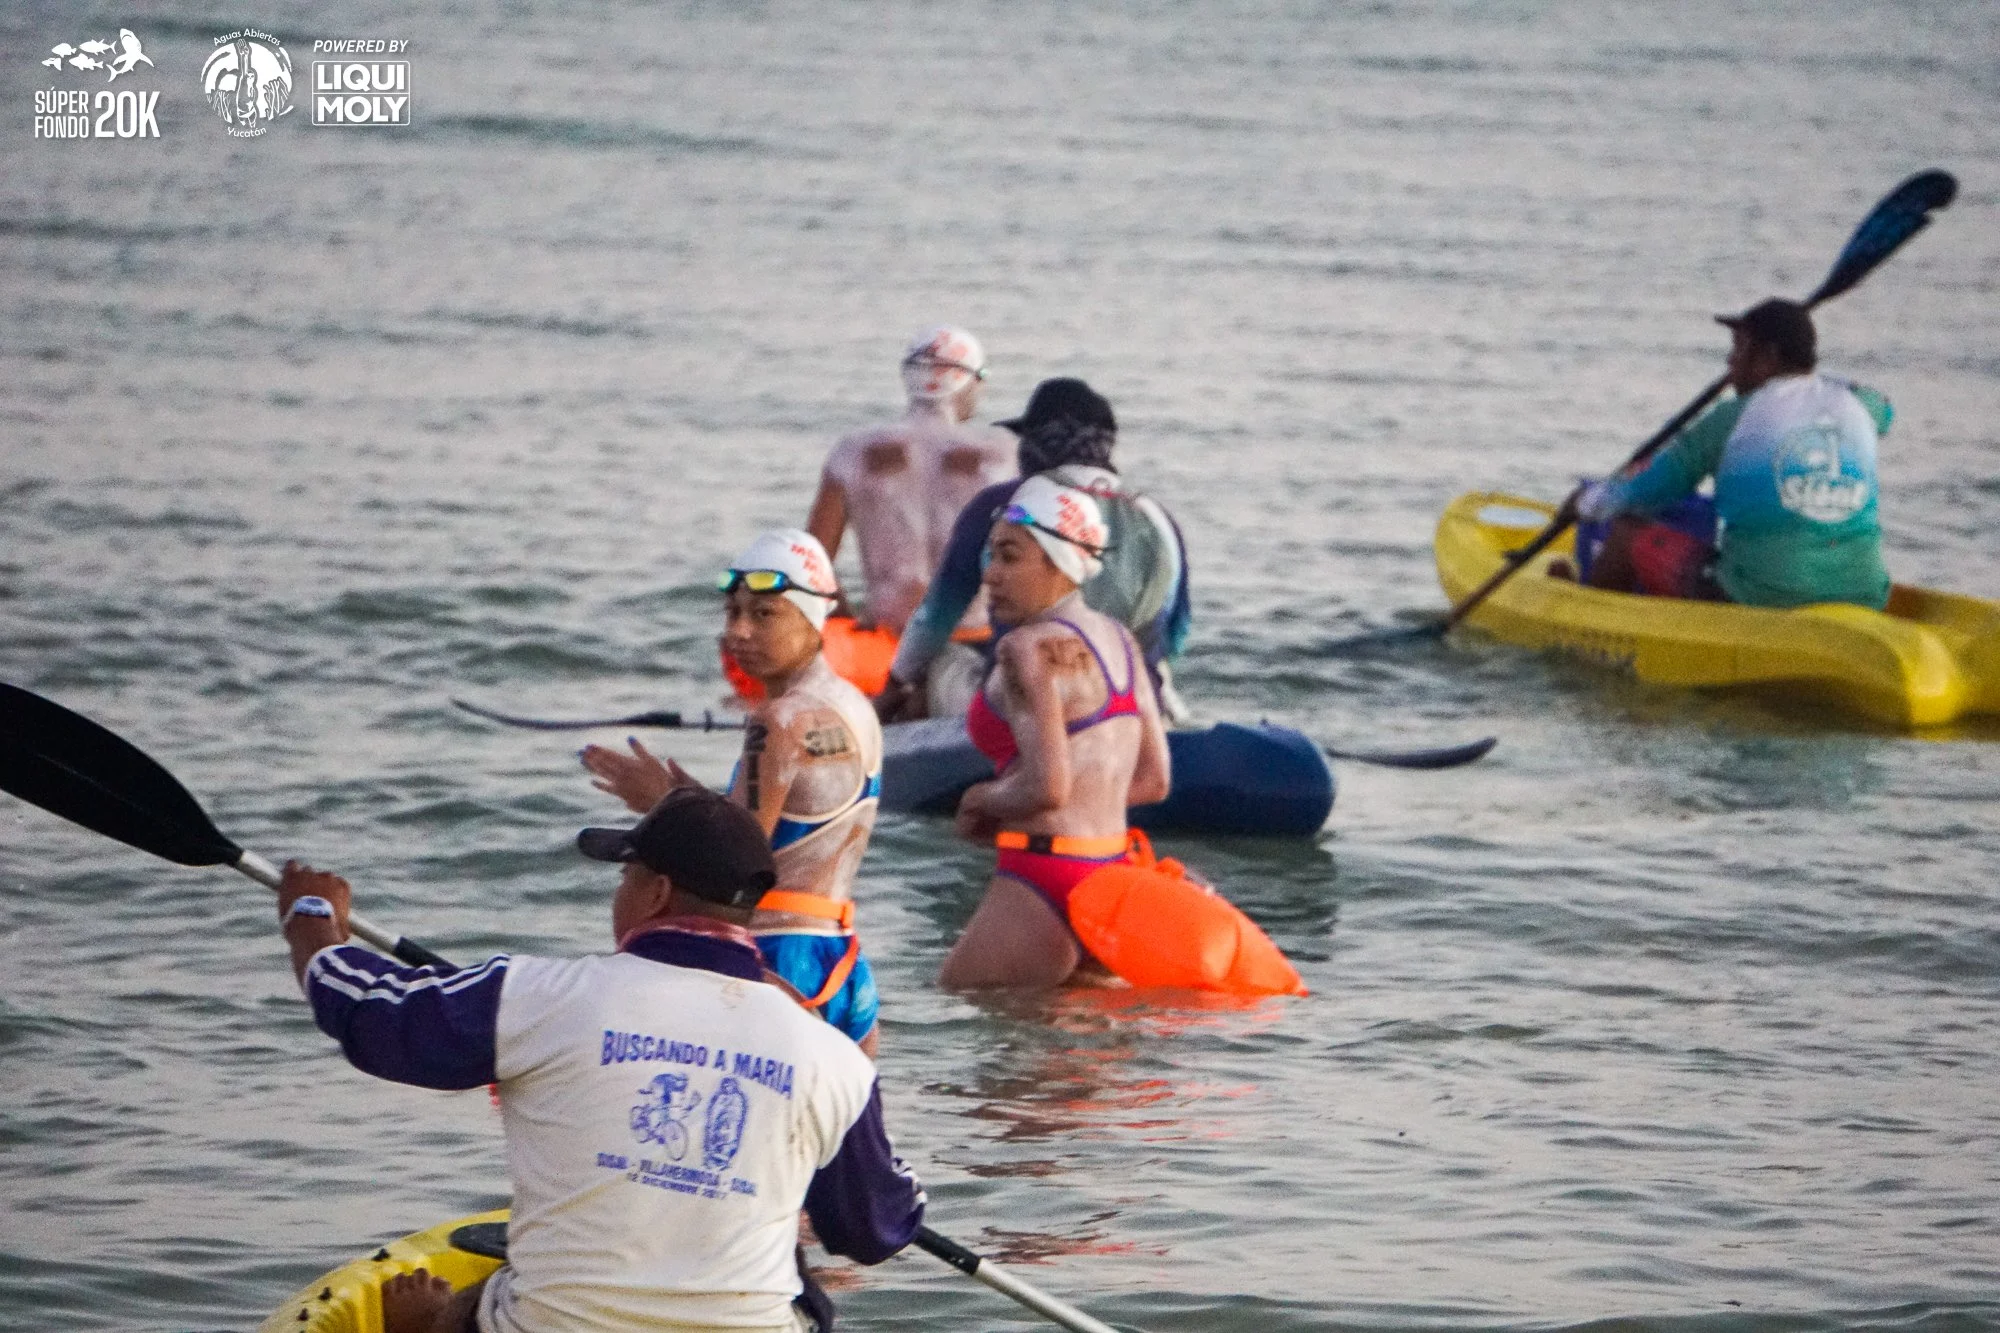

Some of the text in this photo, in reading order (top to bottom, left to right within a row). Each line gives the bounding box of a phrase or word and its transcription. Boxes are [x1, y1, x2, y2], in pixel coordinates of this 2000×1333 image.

[600, 1030, 794, 1098] BUSCANDO A MARIA
